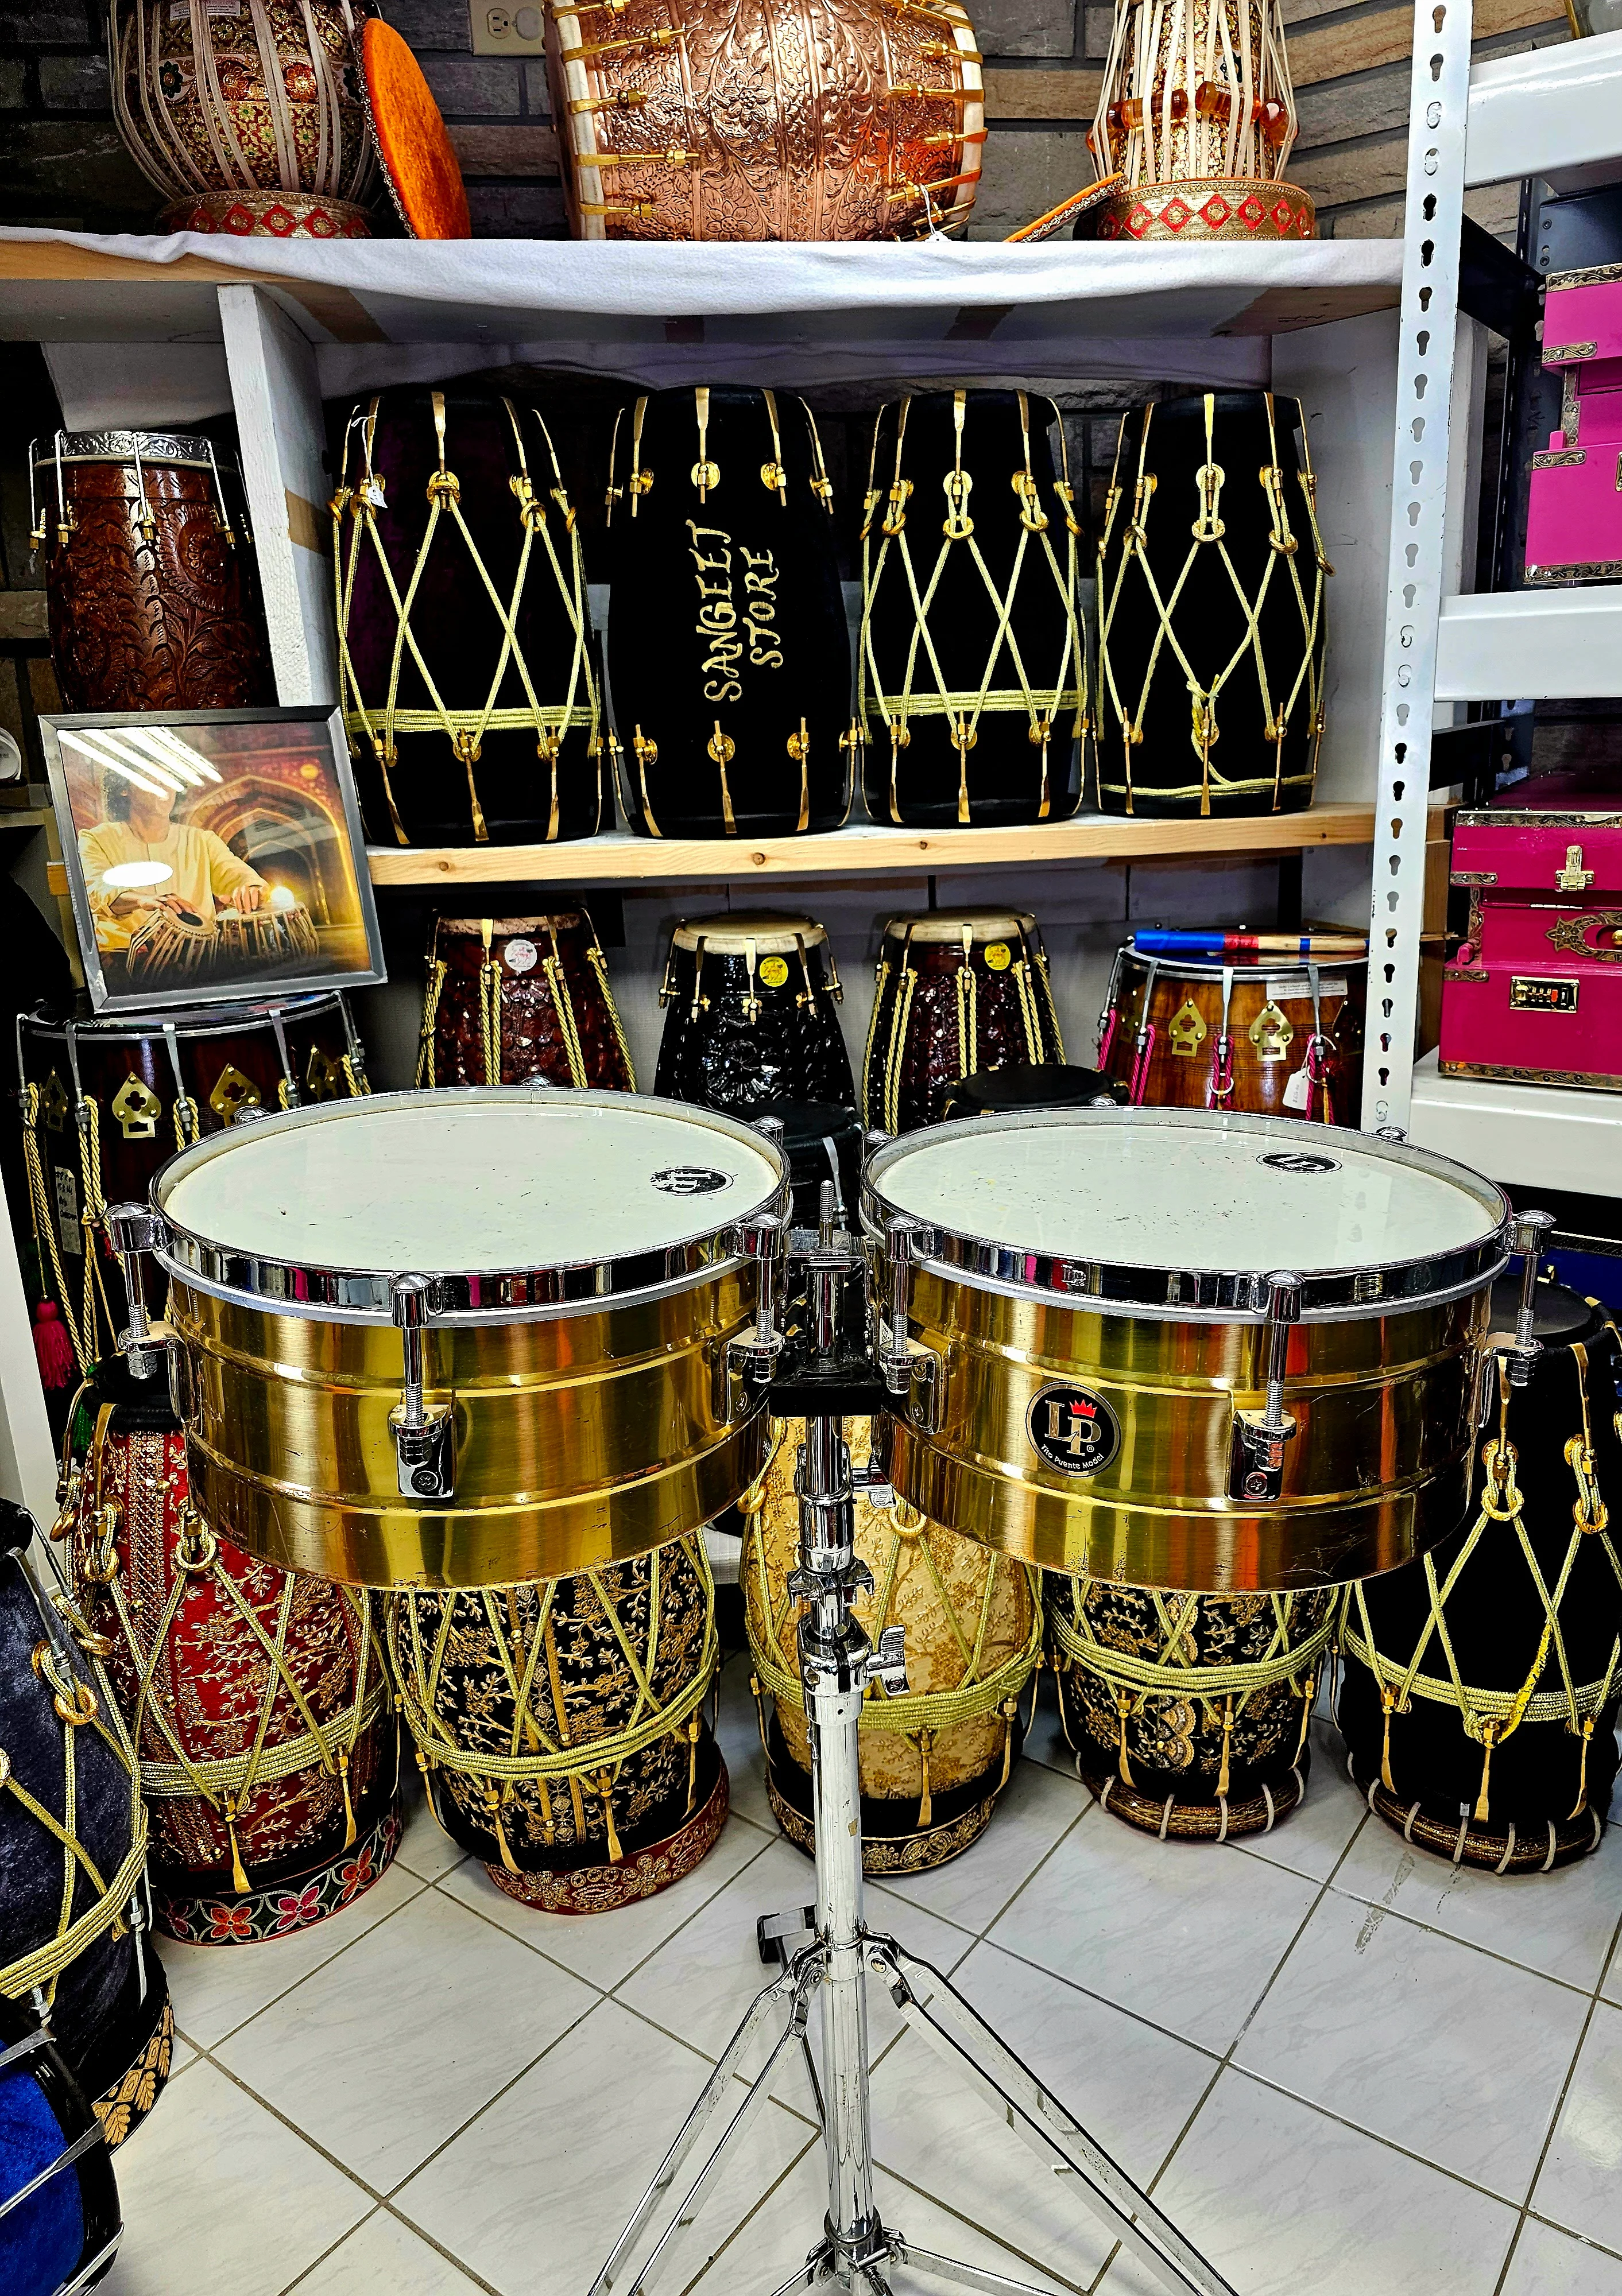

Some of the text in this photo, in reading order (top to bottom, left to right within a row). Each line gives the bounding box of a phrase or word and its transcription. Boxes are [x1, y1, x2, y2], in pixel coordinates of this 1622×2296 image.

[685, 519, 743, 701] SANGEET
[739, 546, 784, 669] STORE
[1040, 1444, 1105, 1469] Tito Puente Model
[1044, 1399, 1102, 1456] LP
